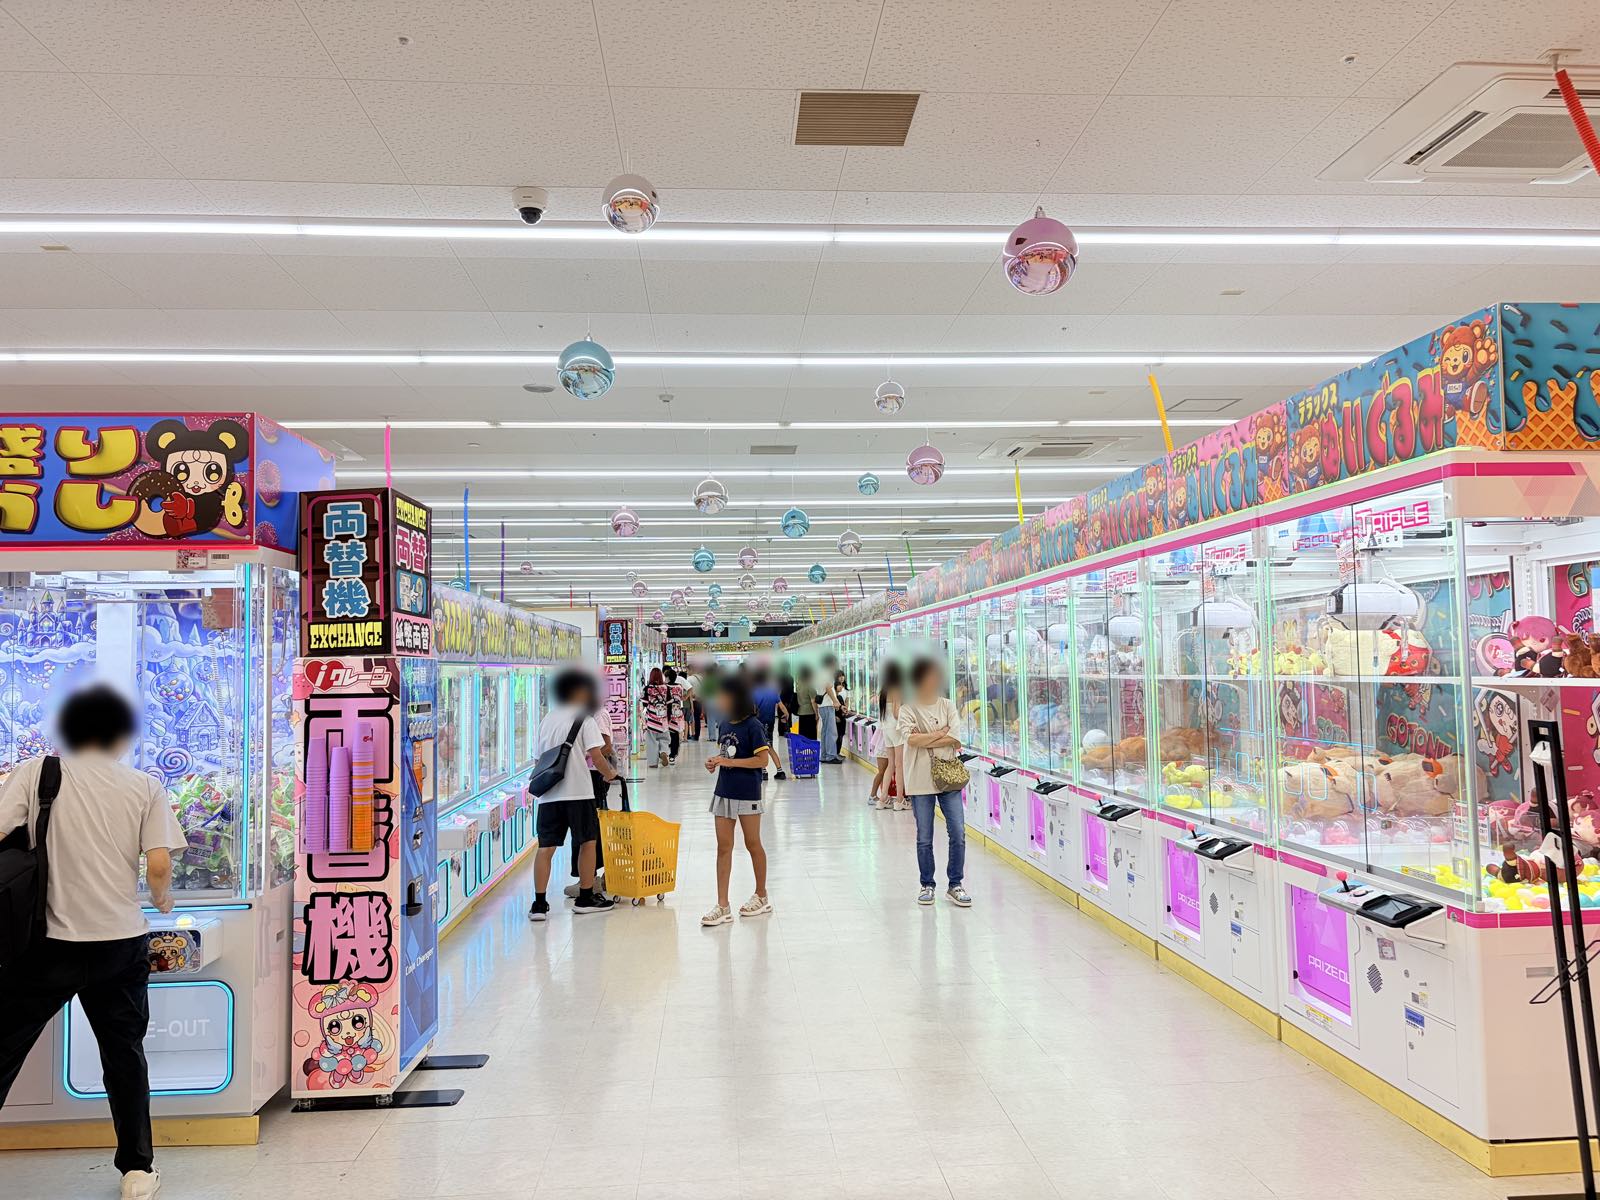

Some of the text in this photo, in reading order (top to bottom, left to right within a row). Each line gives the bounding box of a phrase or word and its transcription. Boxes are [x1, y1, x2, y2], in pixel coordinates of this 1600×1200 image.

[1299, 383, 1338, 424] デラックス
[1320, 367, 1445, 481] ぬいぐるみ
[396, 497, 427, 530] EXCHANGE
[1355, 501, 1430, 537] TRIPLE
[322, 501, 371, 619] 両替機
[395, 525, 428, 575] 両替
[309, 622, 383, 649] EXCHANGE
[394, 617, 430, 653] 紙幣両替
